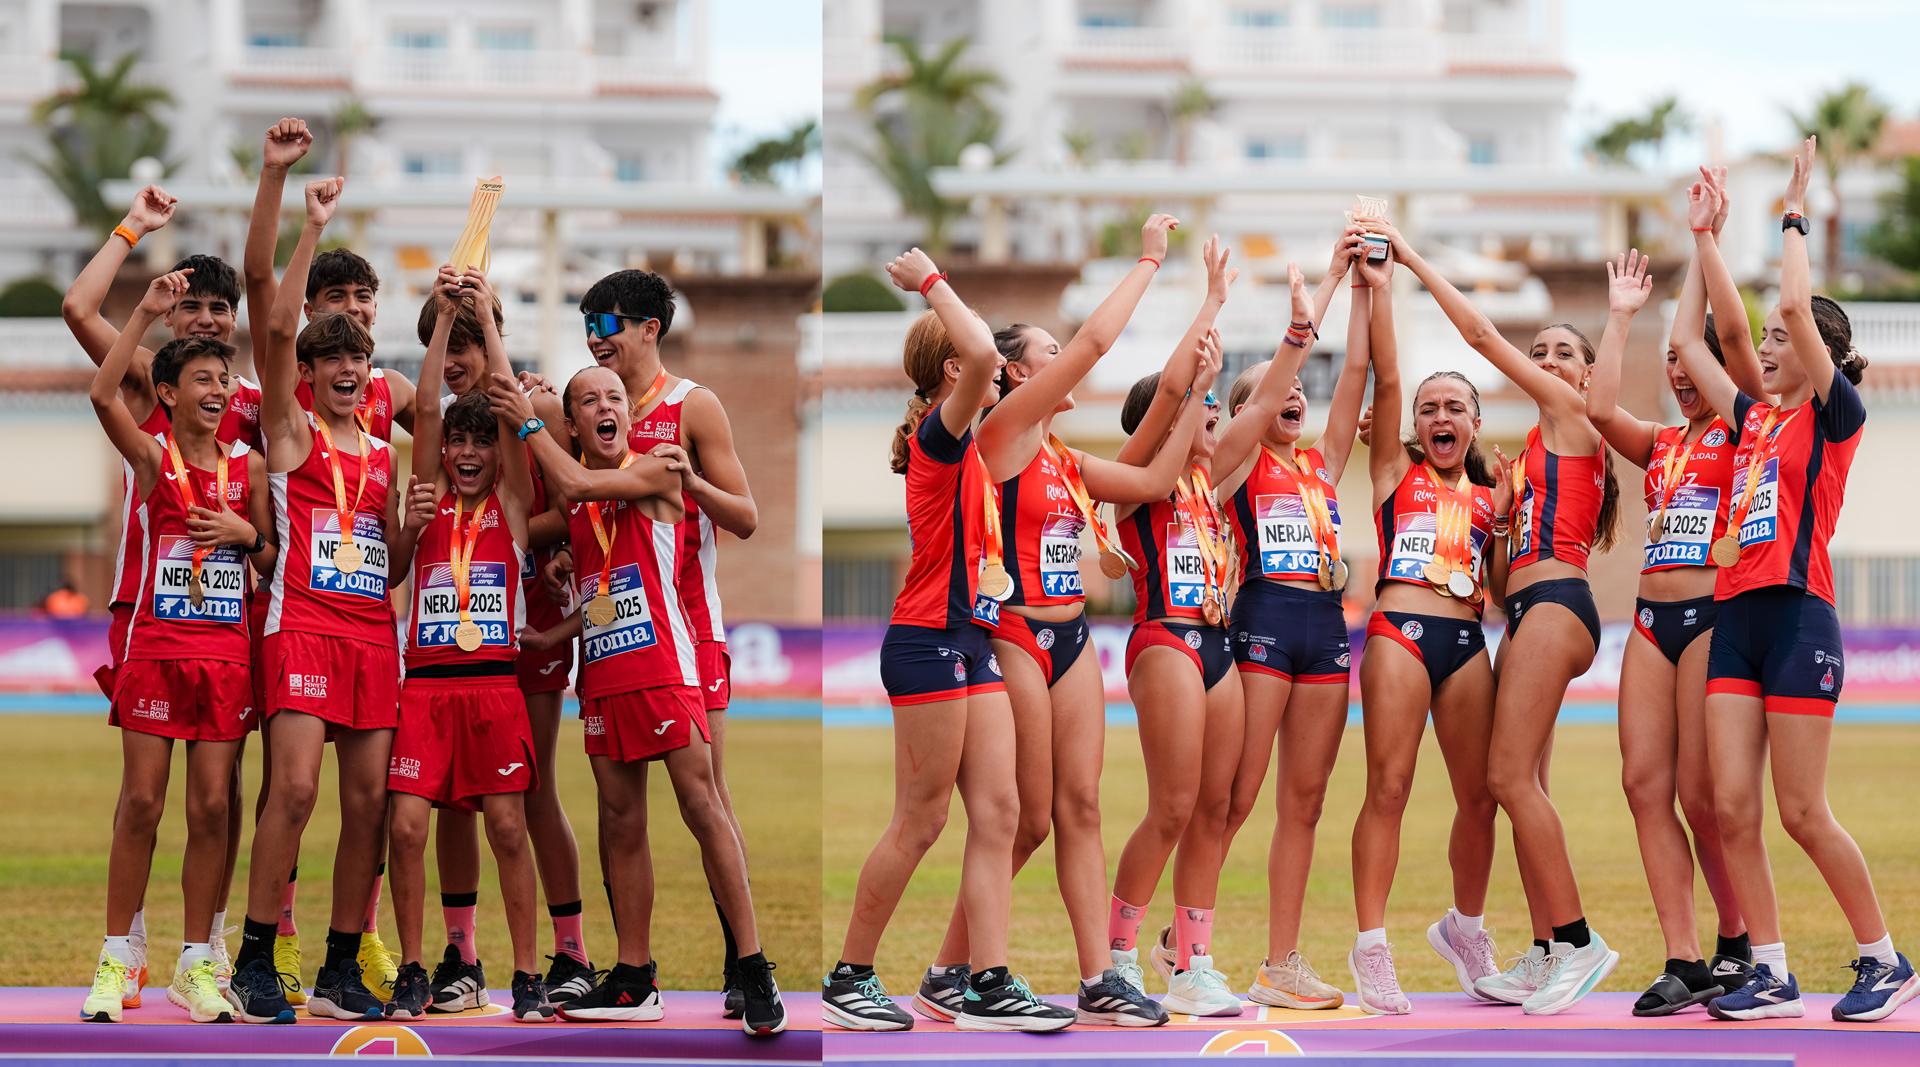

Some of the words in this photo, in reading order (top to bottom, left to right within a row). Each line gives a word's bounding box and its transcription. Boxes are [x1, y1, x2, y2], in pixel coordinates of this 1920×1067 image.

[656, 421, 677, 429] CITD
[654, 431, 675, 440] ROJA
[1265, 524, 1313, 544] NERJA
[1673, 515, 1707, 535] 2025
[1400, 536, 1437, 556] NERJ
[1649, 544, 1702, 565] Joma
[364, 545, 386, 569] 2025
[1174, 554, 1208, 576] NER
[162, 566, 210, 589] NERA
[213, 569, 241, 591] 2025
[335, 571, 385, 596] Joma
[178, 598, 241, 618] Joma
[469, 593, 502, 613] 2025
[612, 595, 642, 621] 025
[438, 623, 505, 643] Ja
[593, 625, 650, 659] Joma
[303, 674, 328, 684] CITD
[304, 687, 327, 697] ROJA
[150, 699, 170, 708] CITD
[149, 711, 169, 720] ROJA
[400, 757, 421, 767] CITD
[398, 768, 419, 778] ROJA
[1717, 959, 1740, 973] NIKE
